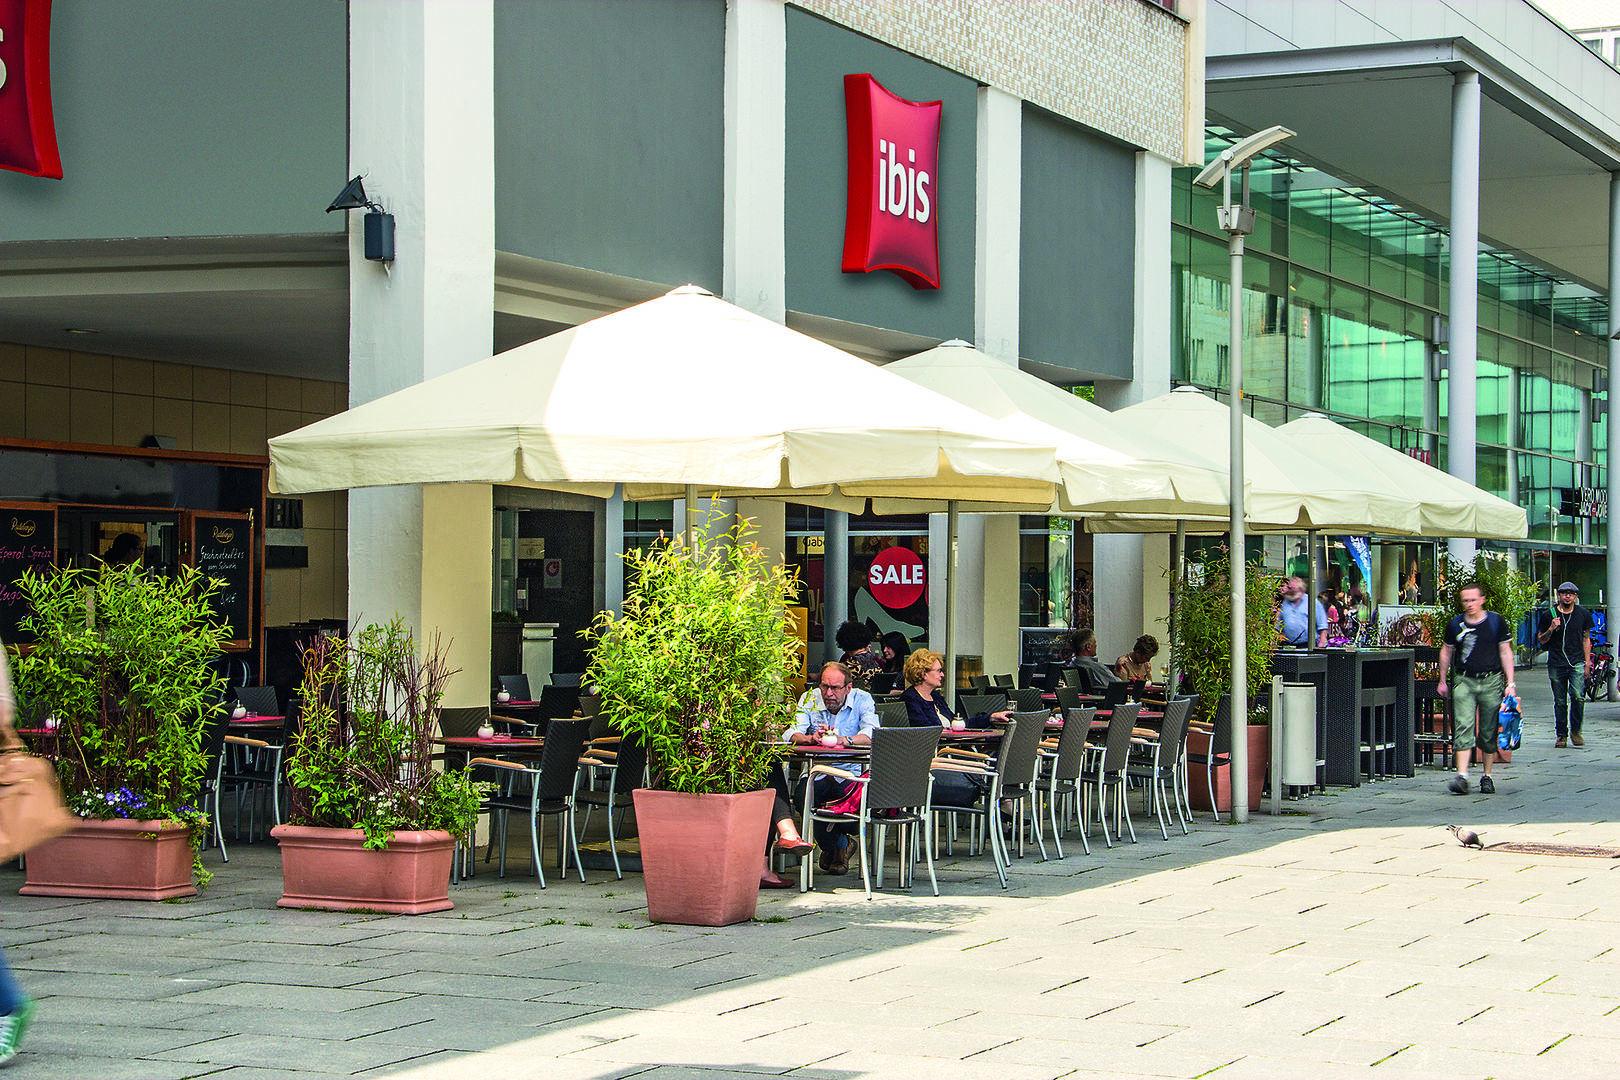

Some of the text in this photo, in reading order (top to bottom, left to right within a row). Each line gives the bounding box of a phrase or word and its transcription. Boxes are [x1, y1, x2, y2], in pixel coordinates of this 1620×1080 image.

[879, 139, 931, 223] ibis
[1595, 489, 1608, 505] MOD
[1596, 503, 1608, 519] JONE
[803, 536, 825, 547] Gab
[869, 564, 924, 585] SALE
